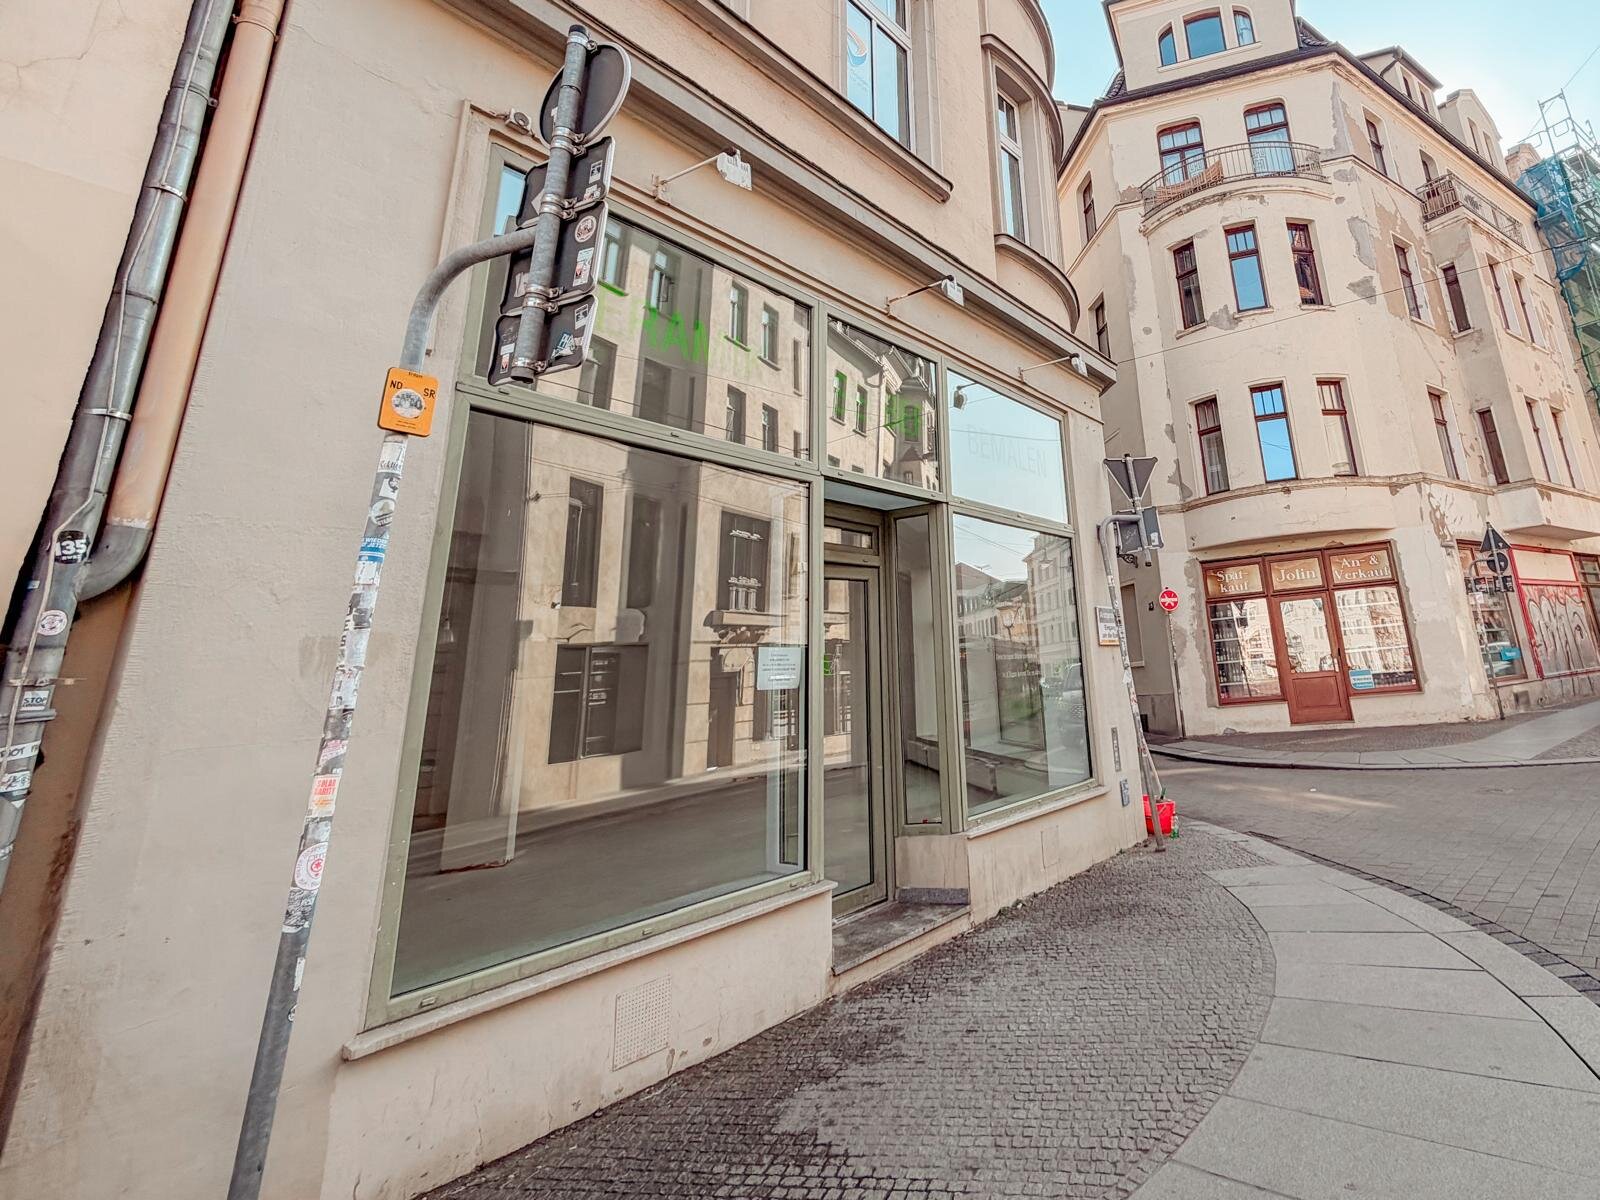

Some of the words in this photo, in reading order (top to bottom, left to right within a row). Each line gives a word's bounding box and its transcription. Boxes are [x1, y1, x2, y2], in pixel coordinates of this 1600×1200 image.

[390, 380, 403, 390] ND
[423, 387, 436, 399] SR
[1341, 557, 1366, 569] An-
[1368, 553, 1379, 565] &
[1276, 568, 1316, 582] Jolin
[1335, 567, 1389, 580] Verkauf
[1219, 581, 1248, 592] kauf
